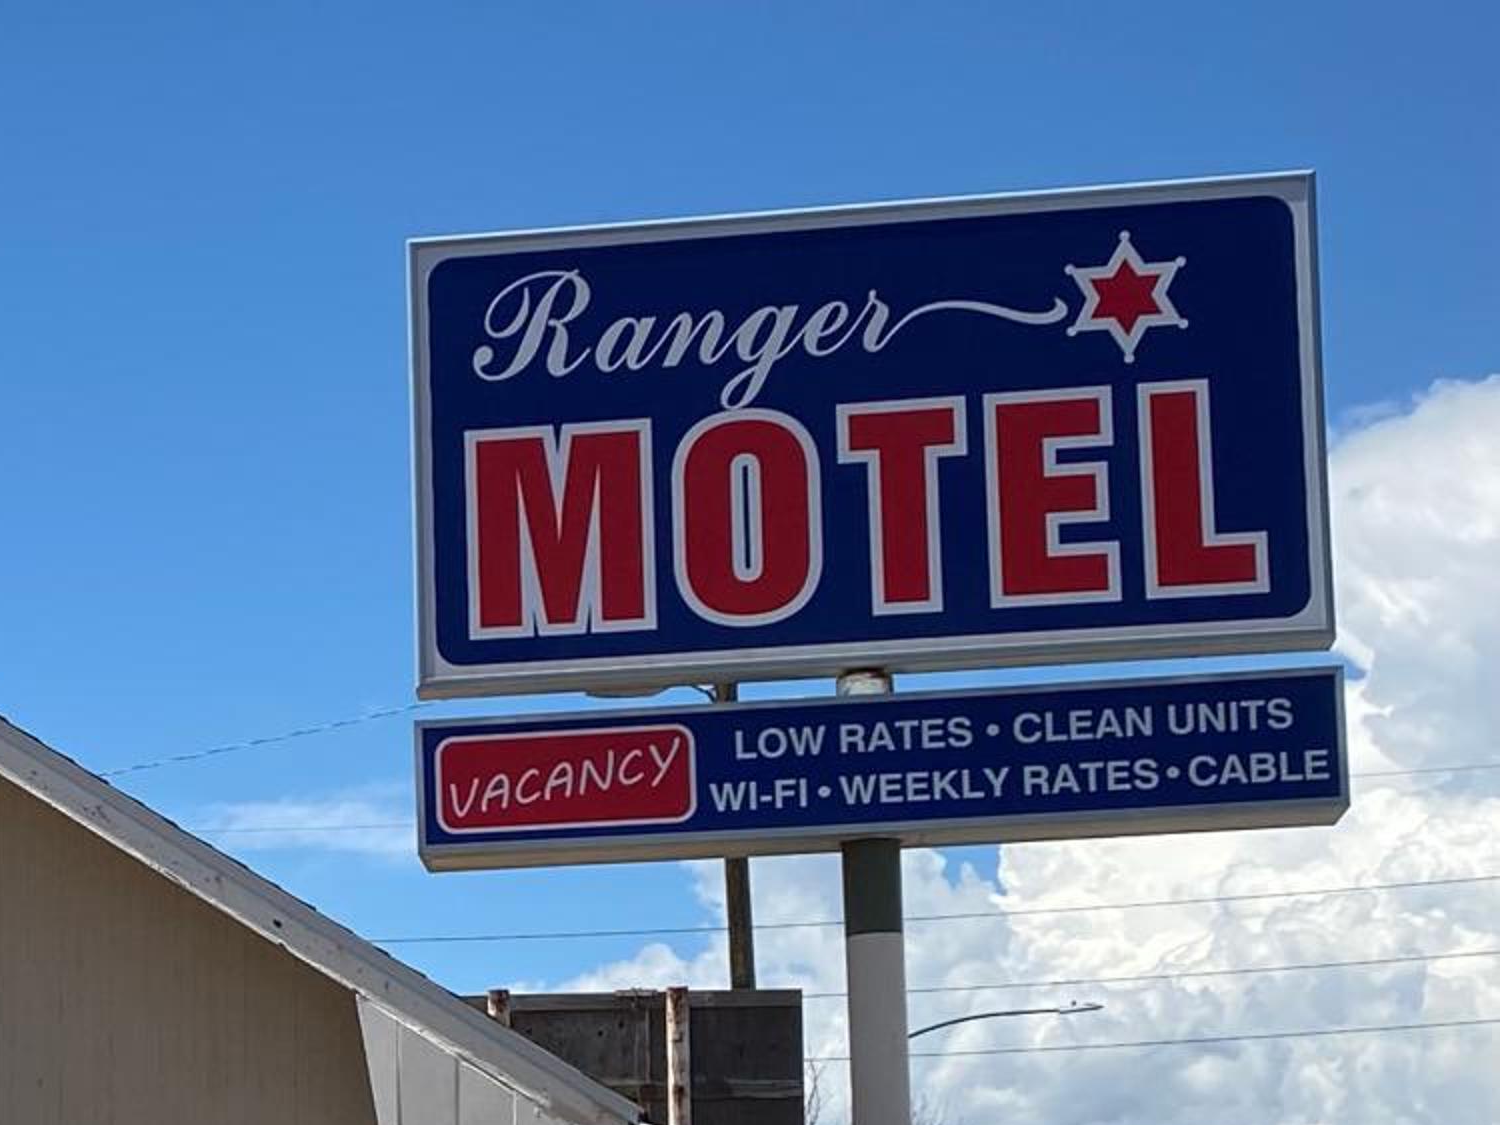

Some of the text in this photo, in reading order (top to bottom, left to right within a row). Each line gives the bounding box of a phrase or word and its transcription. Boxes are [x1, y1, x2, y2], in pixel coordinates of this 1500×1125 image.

[472, 268, 900, 410] Ranger
[464, 378, 1271, 640] MOTEL
[735, 698, 1294, 760] LOW RATES CLEAN UNITS
[450, 736, 681, 818] VACANCY
[709, 749, 1331, 812] WI-FI WEEKLY RATES CABLE
